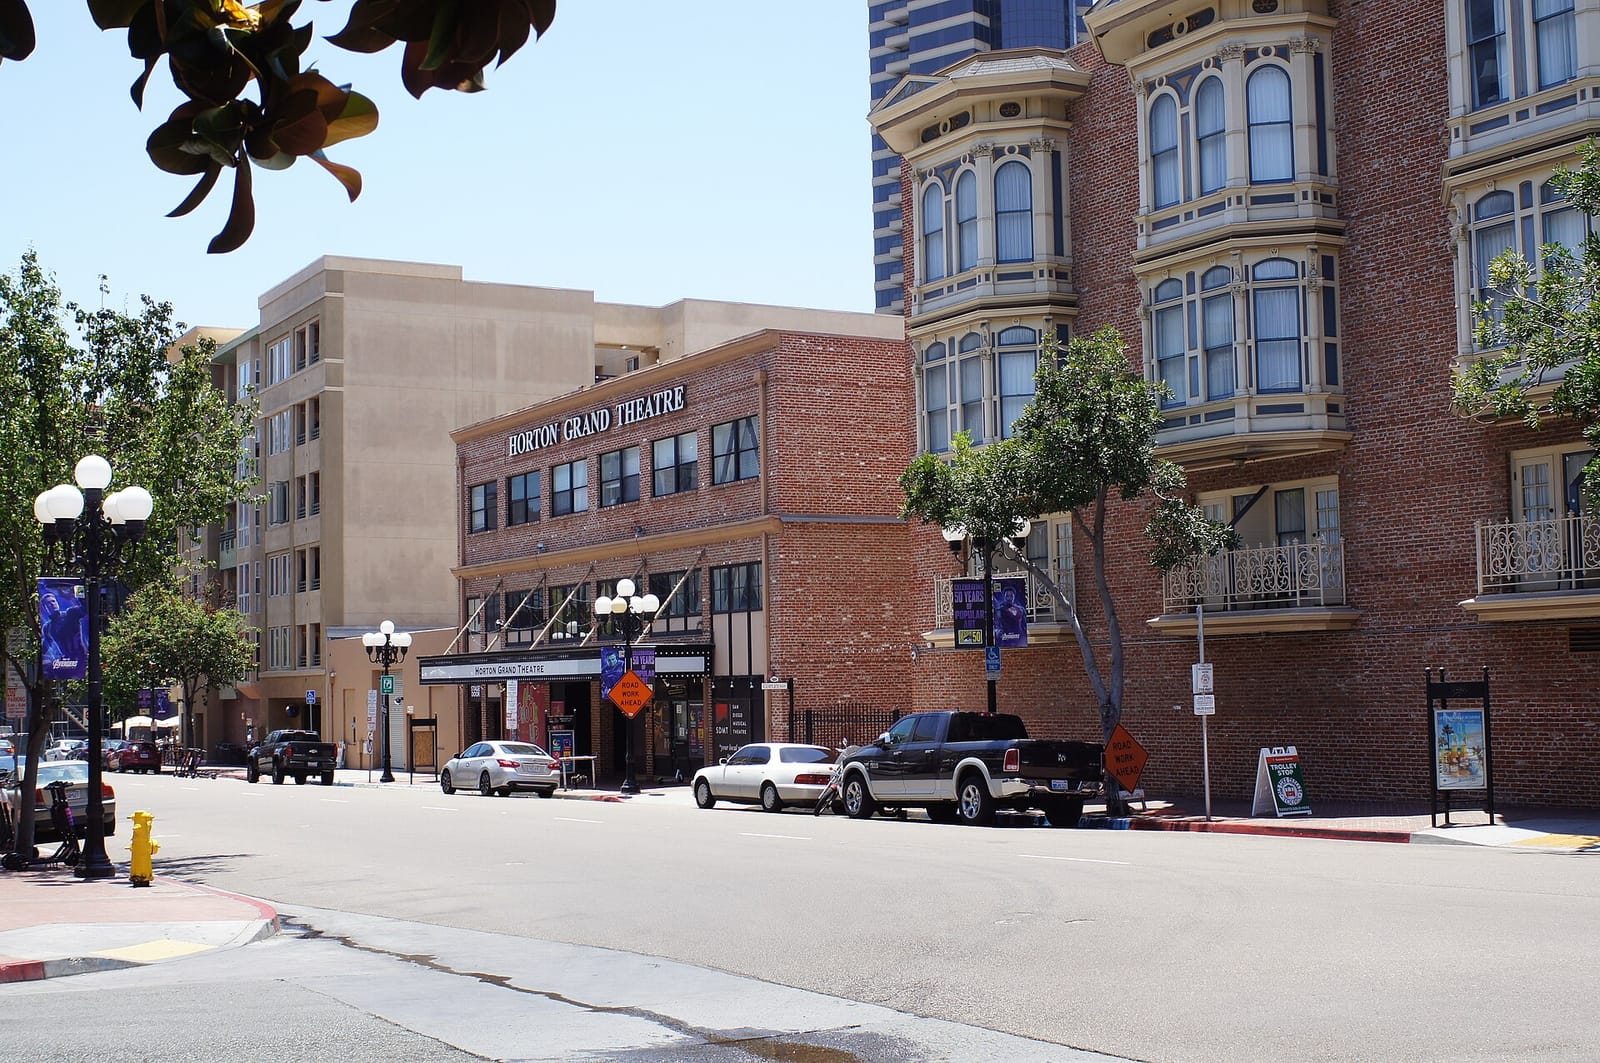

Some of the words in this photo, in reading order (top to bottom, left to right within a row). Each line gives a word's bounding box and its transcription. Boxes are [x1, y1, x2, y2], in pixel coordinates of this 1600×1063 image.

[509, 423, 559, 456] HORTON
[563, 409, 610, 441] GRAND
[616, 386, 684, 427] THEATRE
[954, 591, 963, 603] 50
[964, 590, 984, 602] YEARS
[972, 631, 981, 642] 50
[640, 655, 655, 665] YEARS
[475, 666, 497, 675] HORTON
[497, 665, 517, 674] GRAND
[517, 664, 545, 673] THEATRE
[1113, 740, 1131, 750] ROAD
[1115, 754, 1133, 763] WORK
[1116, 766, 1138, 776] AHEAD
